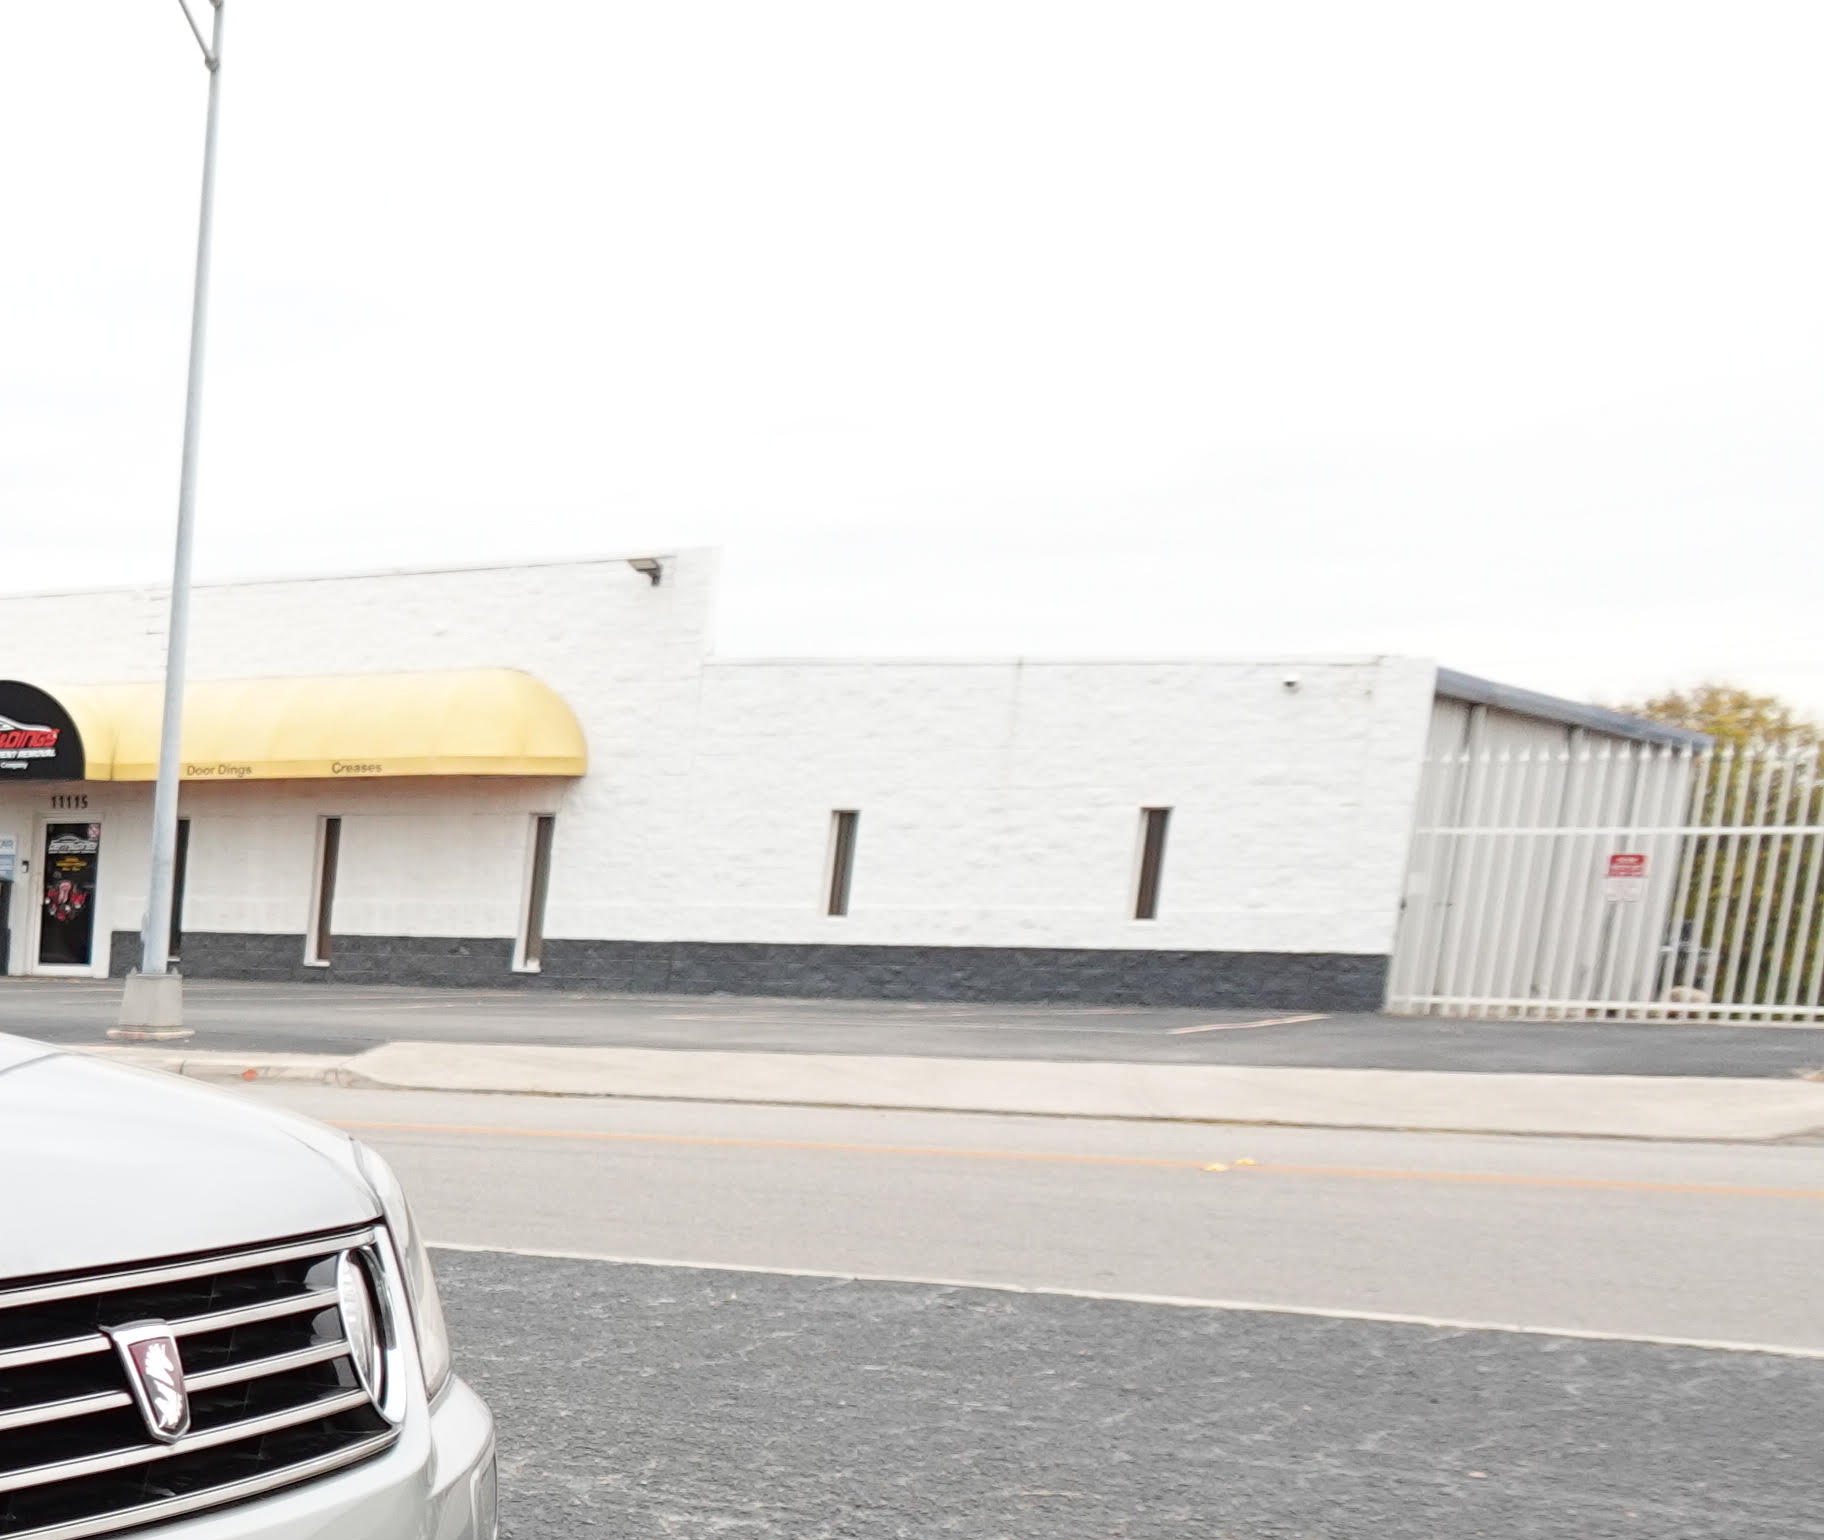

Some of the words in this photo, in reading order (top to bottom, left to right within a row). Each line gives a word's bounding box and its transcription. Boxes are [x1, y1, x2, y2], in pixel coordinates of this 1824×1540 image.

[186, 765, 214, 776] Door
[218, 764, 253, 777] Dings
[332, 761, 383, 774] Creases
[51, 793, 88, 809] 11115
